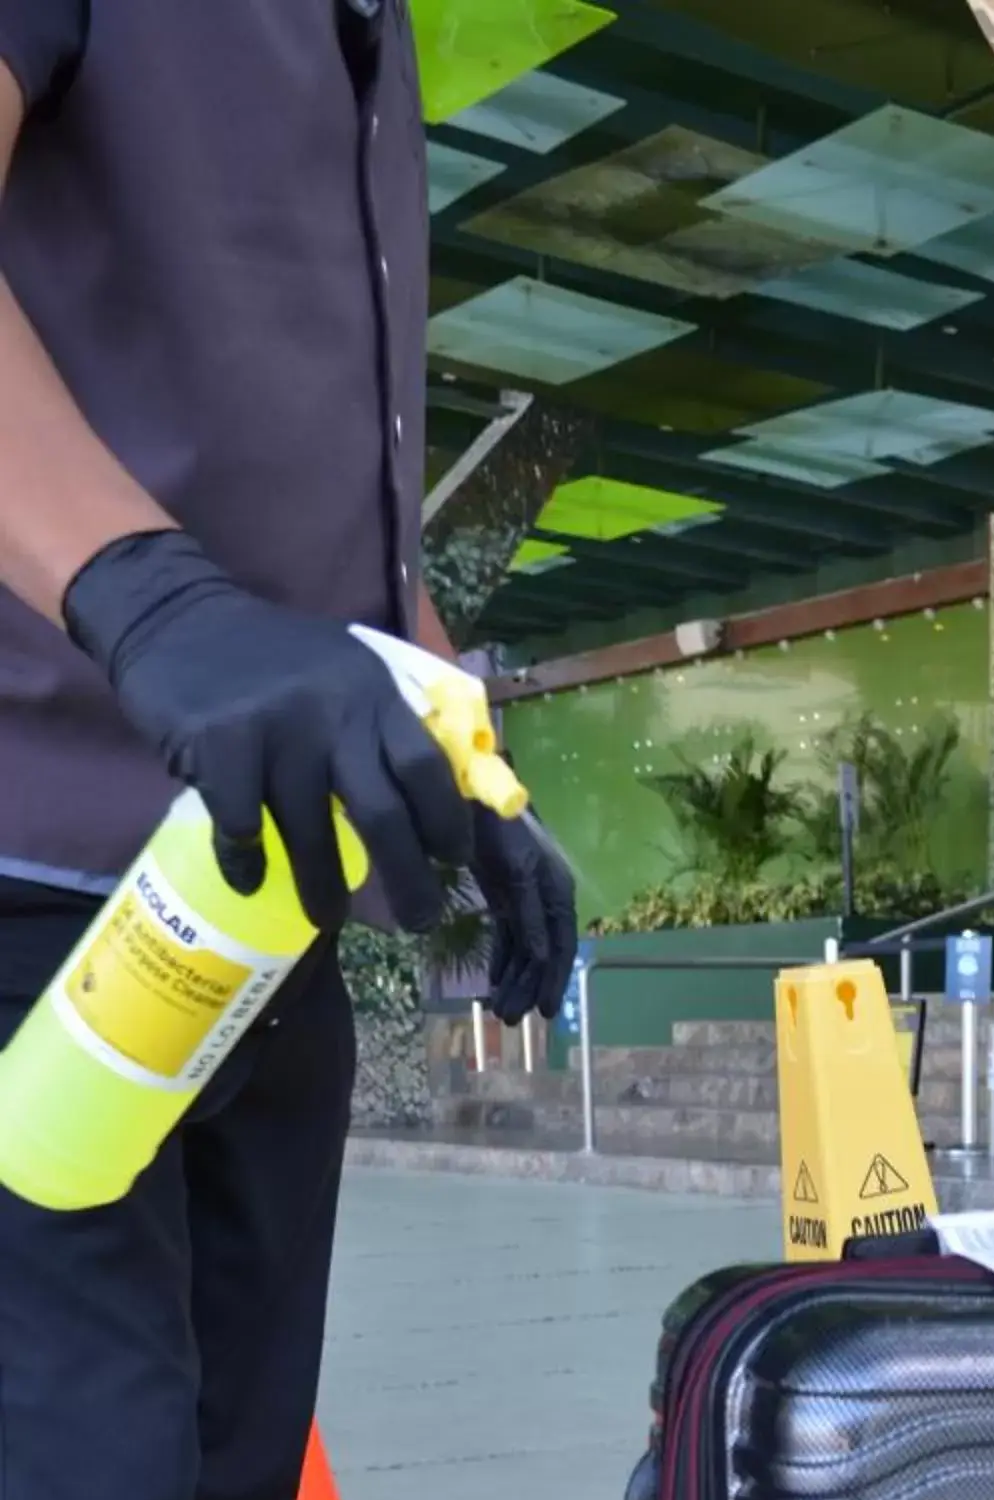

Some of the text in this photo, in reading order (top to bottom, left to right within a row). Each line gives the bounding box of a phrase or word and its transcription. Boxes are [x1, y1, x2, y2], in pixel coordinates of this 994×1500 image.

[136, 871, 198, 945] ECOLAB
[789, 1215, 828, 1249] CAUTION
[851, 1202, 927, 1239] CAUTION
